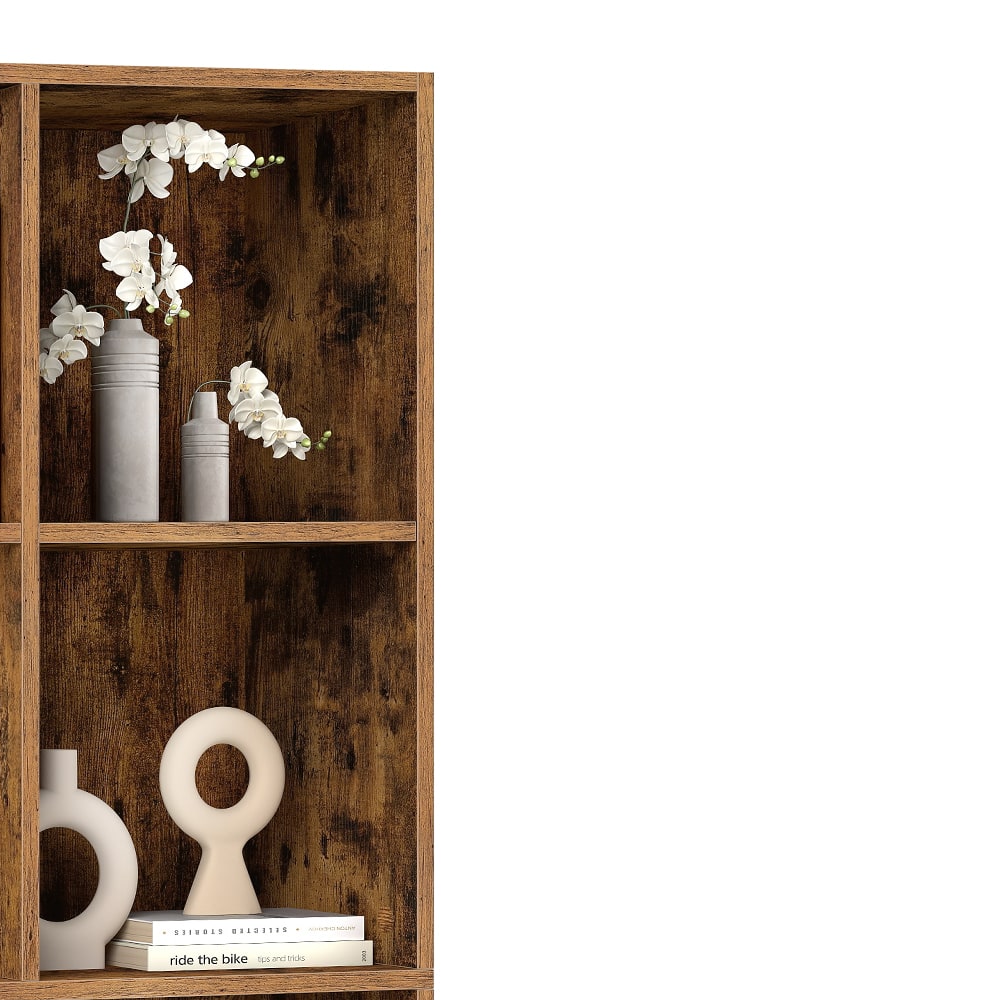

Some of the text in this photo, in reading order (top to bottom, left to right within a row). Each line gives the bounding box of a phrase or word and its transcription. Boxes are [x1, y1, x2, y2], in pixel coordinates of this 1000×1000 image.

[174, 928, 224, 936] STORIES
[170, 953, 248, 966] ride the bike
[257, 953, 306, 963] tips and tricks
